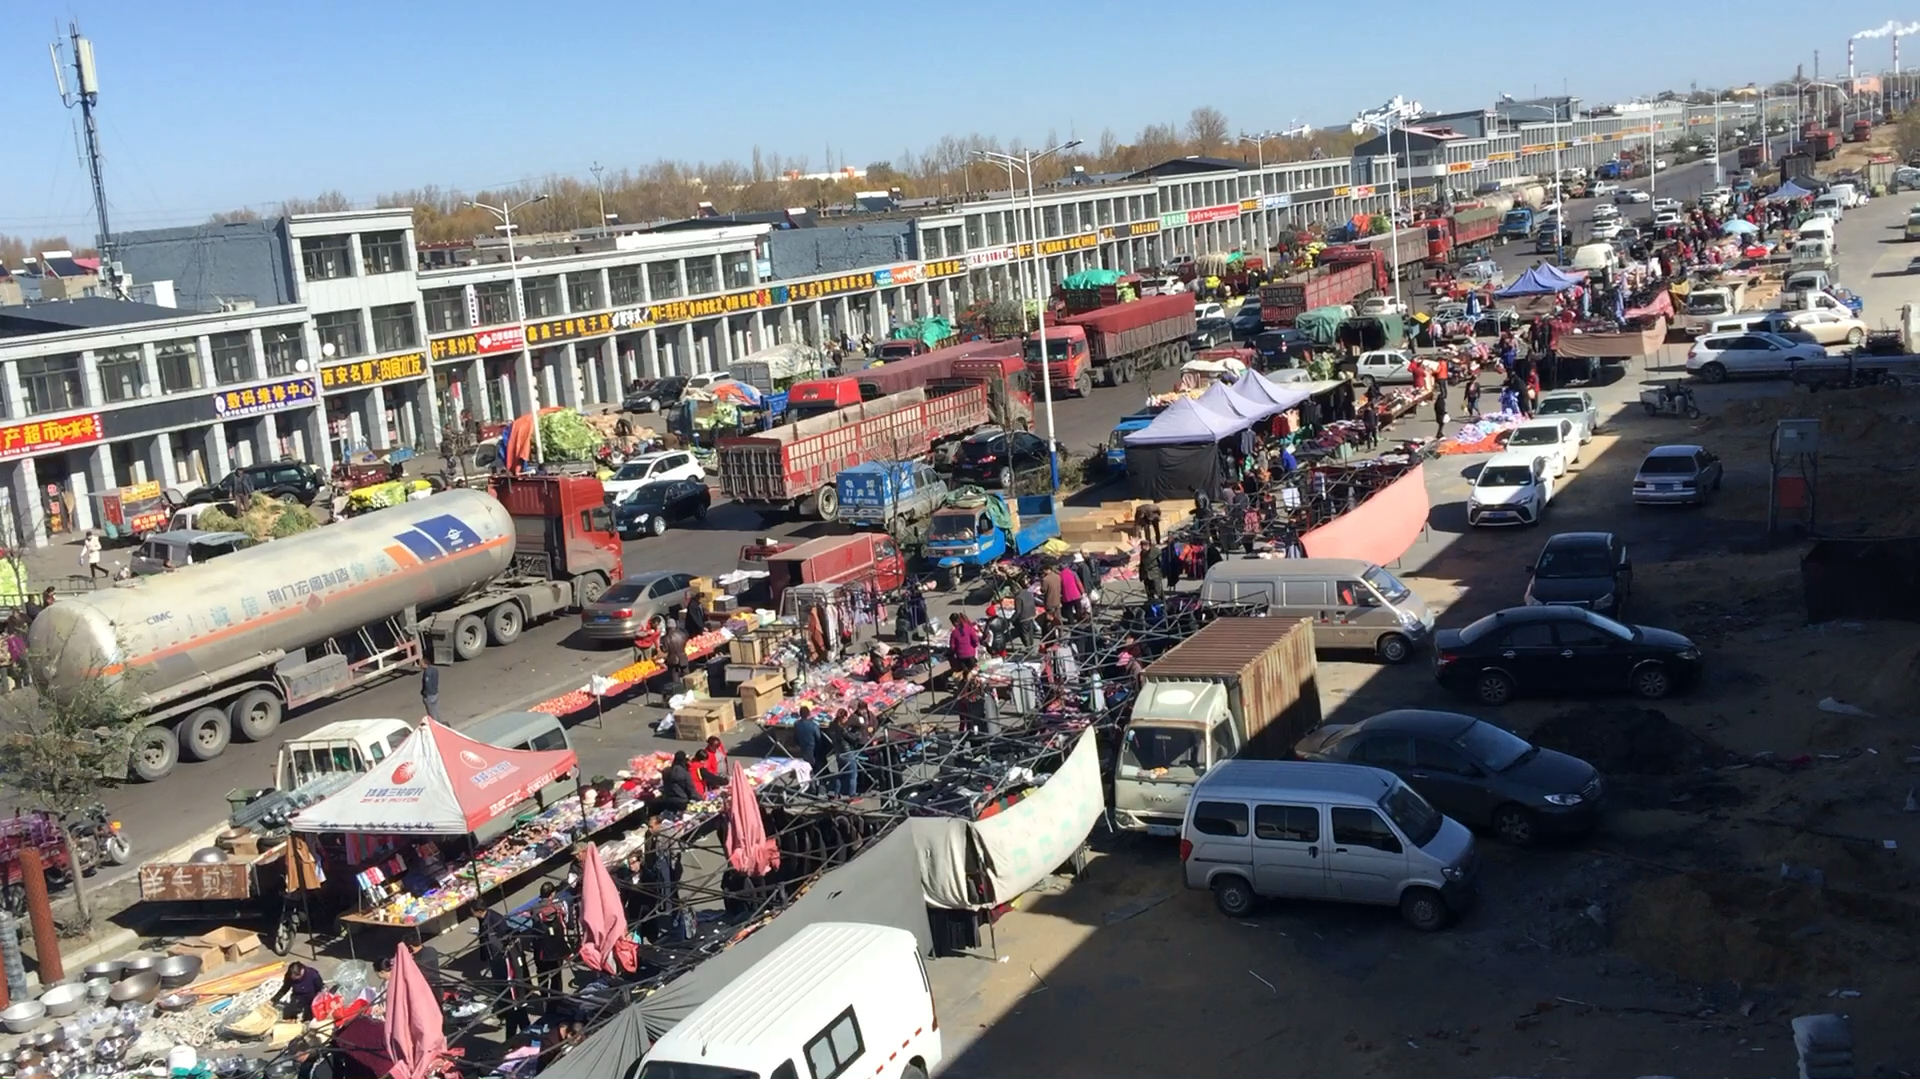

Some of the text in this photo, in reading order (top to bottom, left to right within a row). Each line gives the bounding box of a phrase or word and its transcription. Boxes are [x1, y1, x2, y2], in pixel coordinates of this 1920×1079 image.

[437, 335, 476, 357] 干果炒货
[380, 354, 421, 380] 肉食批发
[226, 381, 314, 409] 数码维修中心
[266, 567, 350, 604] 荆门宏图制造
[146, 610, 173, 625] CIMC
